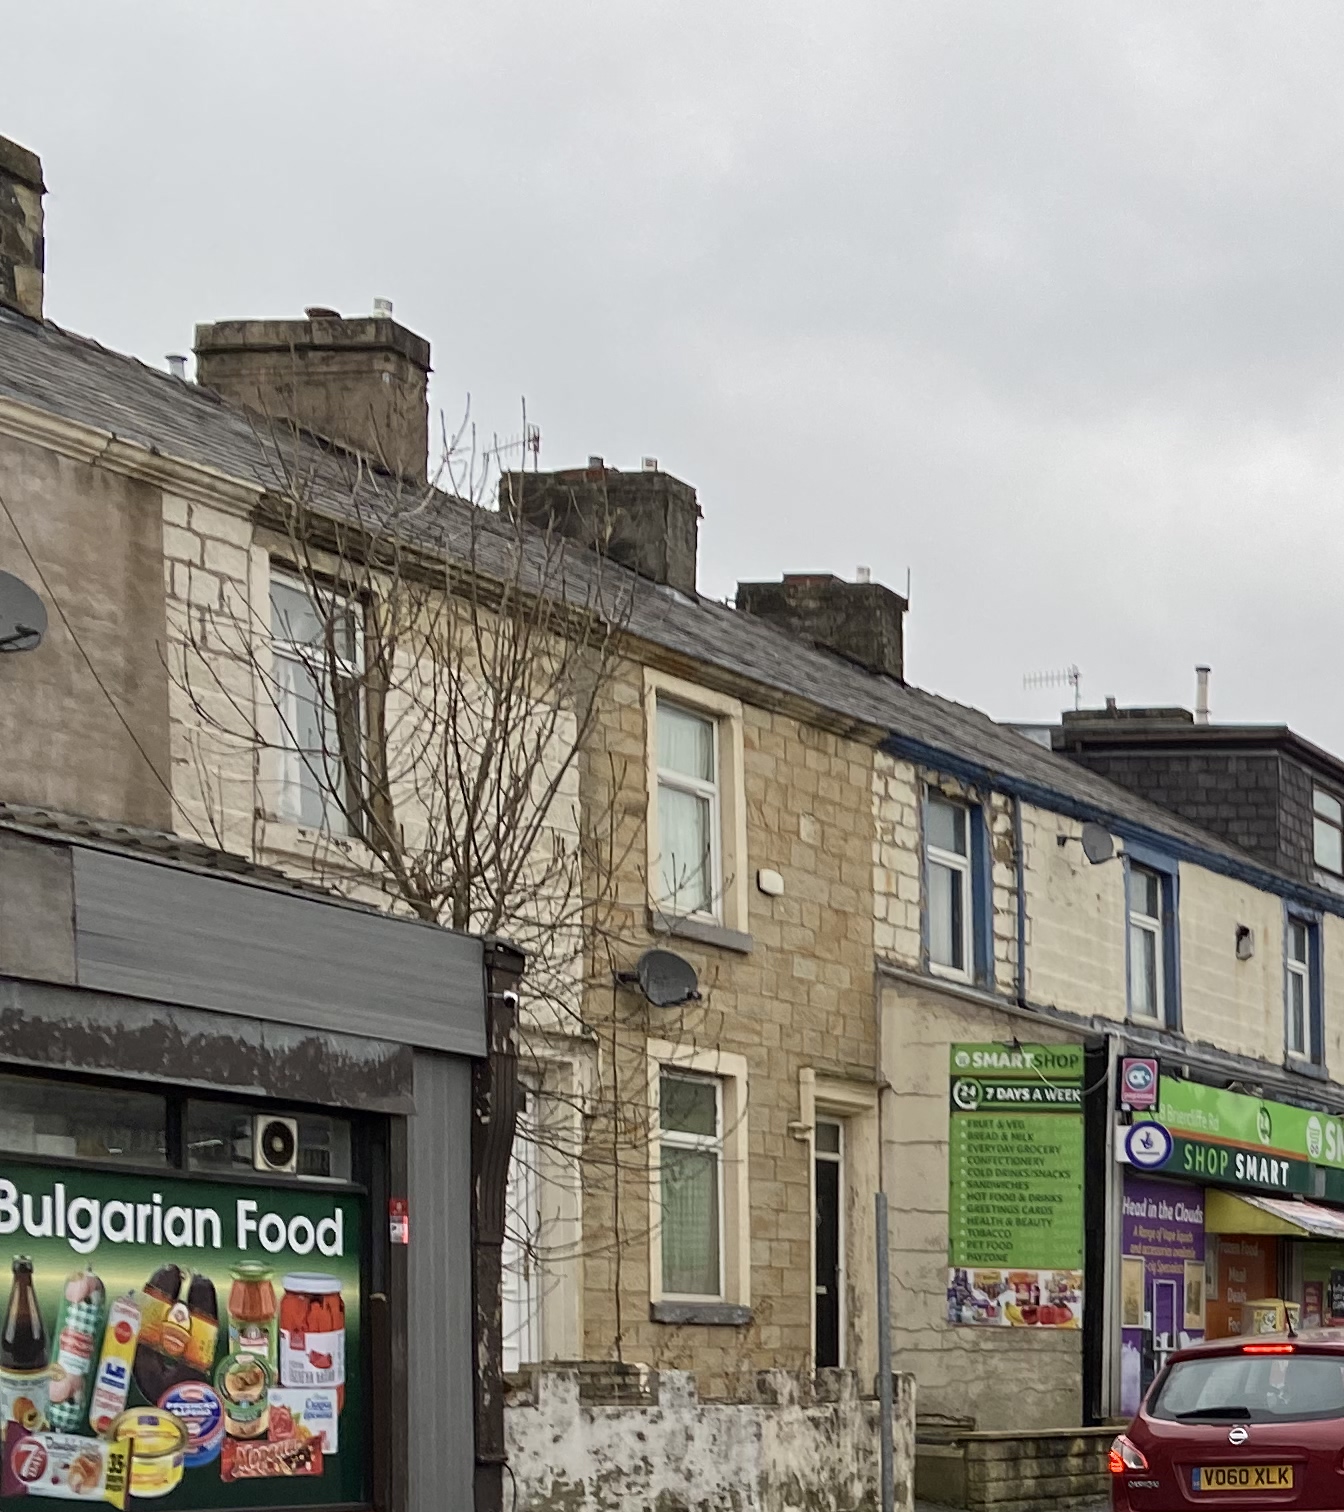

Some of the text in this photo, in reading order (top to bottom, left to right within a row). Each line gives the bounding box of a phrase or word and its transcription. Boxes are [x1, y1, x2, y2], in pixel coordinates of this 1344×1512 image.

[985, 1087, 1081, 1102] 7 DAYS A WEEK
[967, 1120, 1025, 1129] FRUIT & VEG
[967, 1132, 1034, 1141] BREAD & MILK
[967, 1144, 1060, 1154] EVERYDAY GROCERY
[967, 1156, 1044, 1166] CONFECTIONERY
[1184, 1144, 1289, 1186] SHOP SMART
[967, 1168, 993, 1177] COLD
[967, 1181, 1029, 1190] SANDWICHES
[967, 1192, 1063, 1202] HOT FOOD & DRINKS
[967, 1204, 1053, 1215] GREETINGS CARDS
[1122, 1196, 1203, 1224] Head in the Clouds
[0, 1177, 222, 1255] Bulgarian
[236, 1199, 344, 1257] Food
[967, 1217, 1053, 1228] HEALTH & BEAUTY
[967, 1229, 1012, 1238] TOBACCO
[967, 1241, 1013, 1250] PET FOOD
[1242, 1242, 1259, 1256] Food
[967, 1253, 1008, 1262] PAYZONE
[20, 1443, 40, 1478] 7
[1204, 1467, 1289, 1486] VO60 XLK
